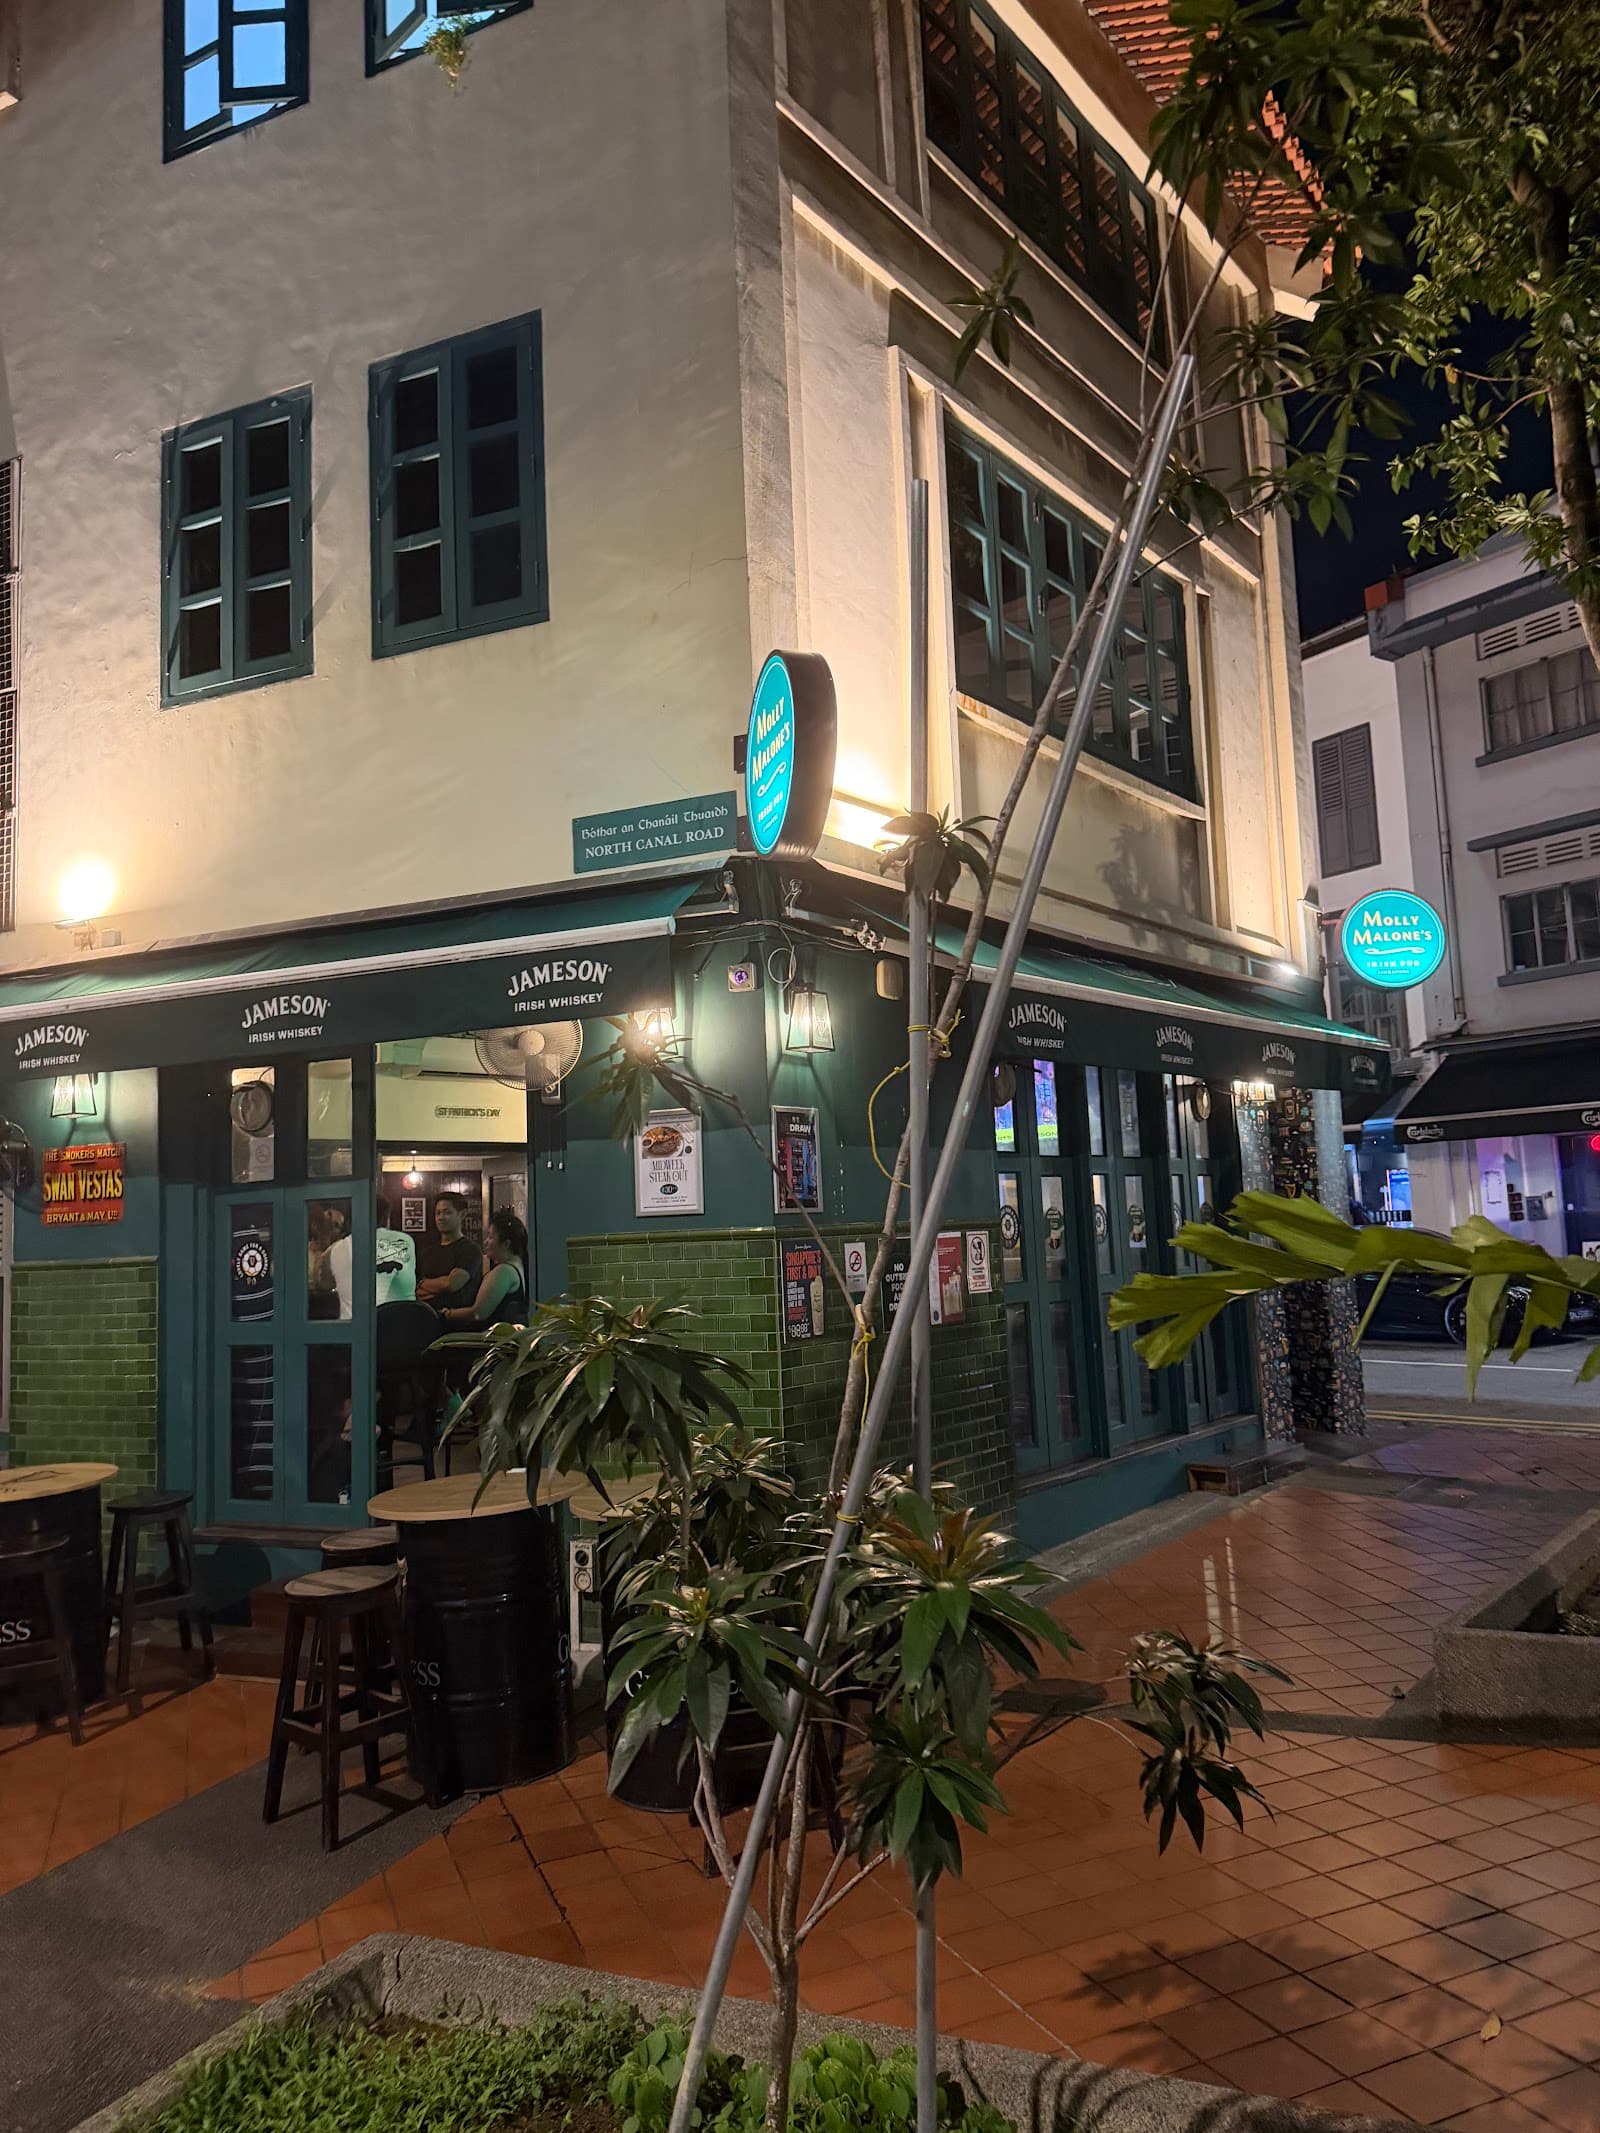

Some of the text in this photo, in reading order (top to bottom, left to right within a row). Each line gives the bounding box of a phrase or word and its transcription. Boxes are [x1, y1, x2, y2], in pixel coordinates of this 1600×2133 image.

[757, 696, 784, 744] MOLLY
[752, 721, 790, 785] MALONE'S
[581, 825, 618, 840] Bóthar
[621, 823, 634, 833] an
[638, 814, 678, 830] Chanáil
[585, 826, 725, 859] NORTH CANAL ROAD
[1363, 910, 1419, 927] MOLLY
[1353, 929, 1432, 945] MALONE'S
[507, 960, 609, 997] JAMESON
[241, 995, 328, 1028] JAMESON
[514, 992, 603, 1012] IRISH WHISKEY
[1008, 1003, 1065, 1032] JAMESON
[14, 1025, 88, 1056] JAMESON
[248, 1025, 323, 1043] IRISH WHISKEY
[1033, 1037, 1065, 1049] WHISKEY
[1156, 1025, 1193, 1051] JAMESON
[19, 1053, 81, 1070] IRISH WHISKEY
[1262, 1042, 1295, 1065] JAMESON
[789, 1123, 811, 1133] DRAW
[43, 1169, 123, 1202] SWAN VESTAS
[46, 1212, 79, 1223] BRYANT
[87, 1210, 105, 1221] MAY
[893, 1263, 905, 1272] NO
